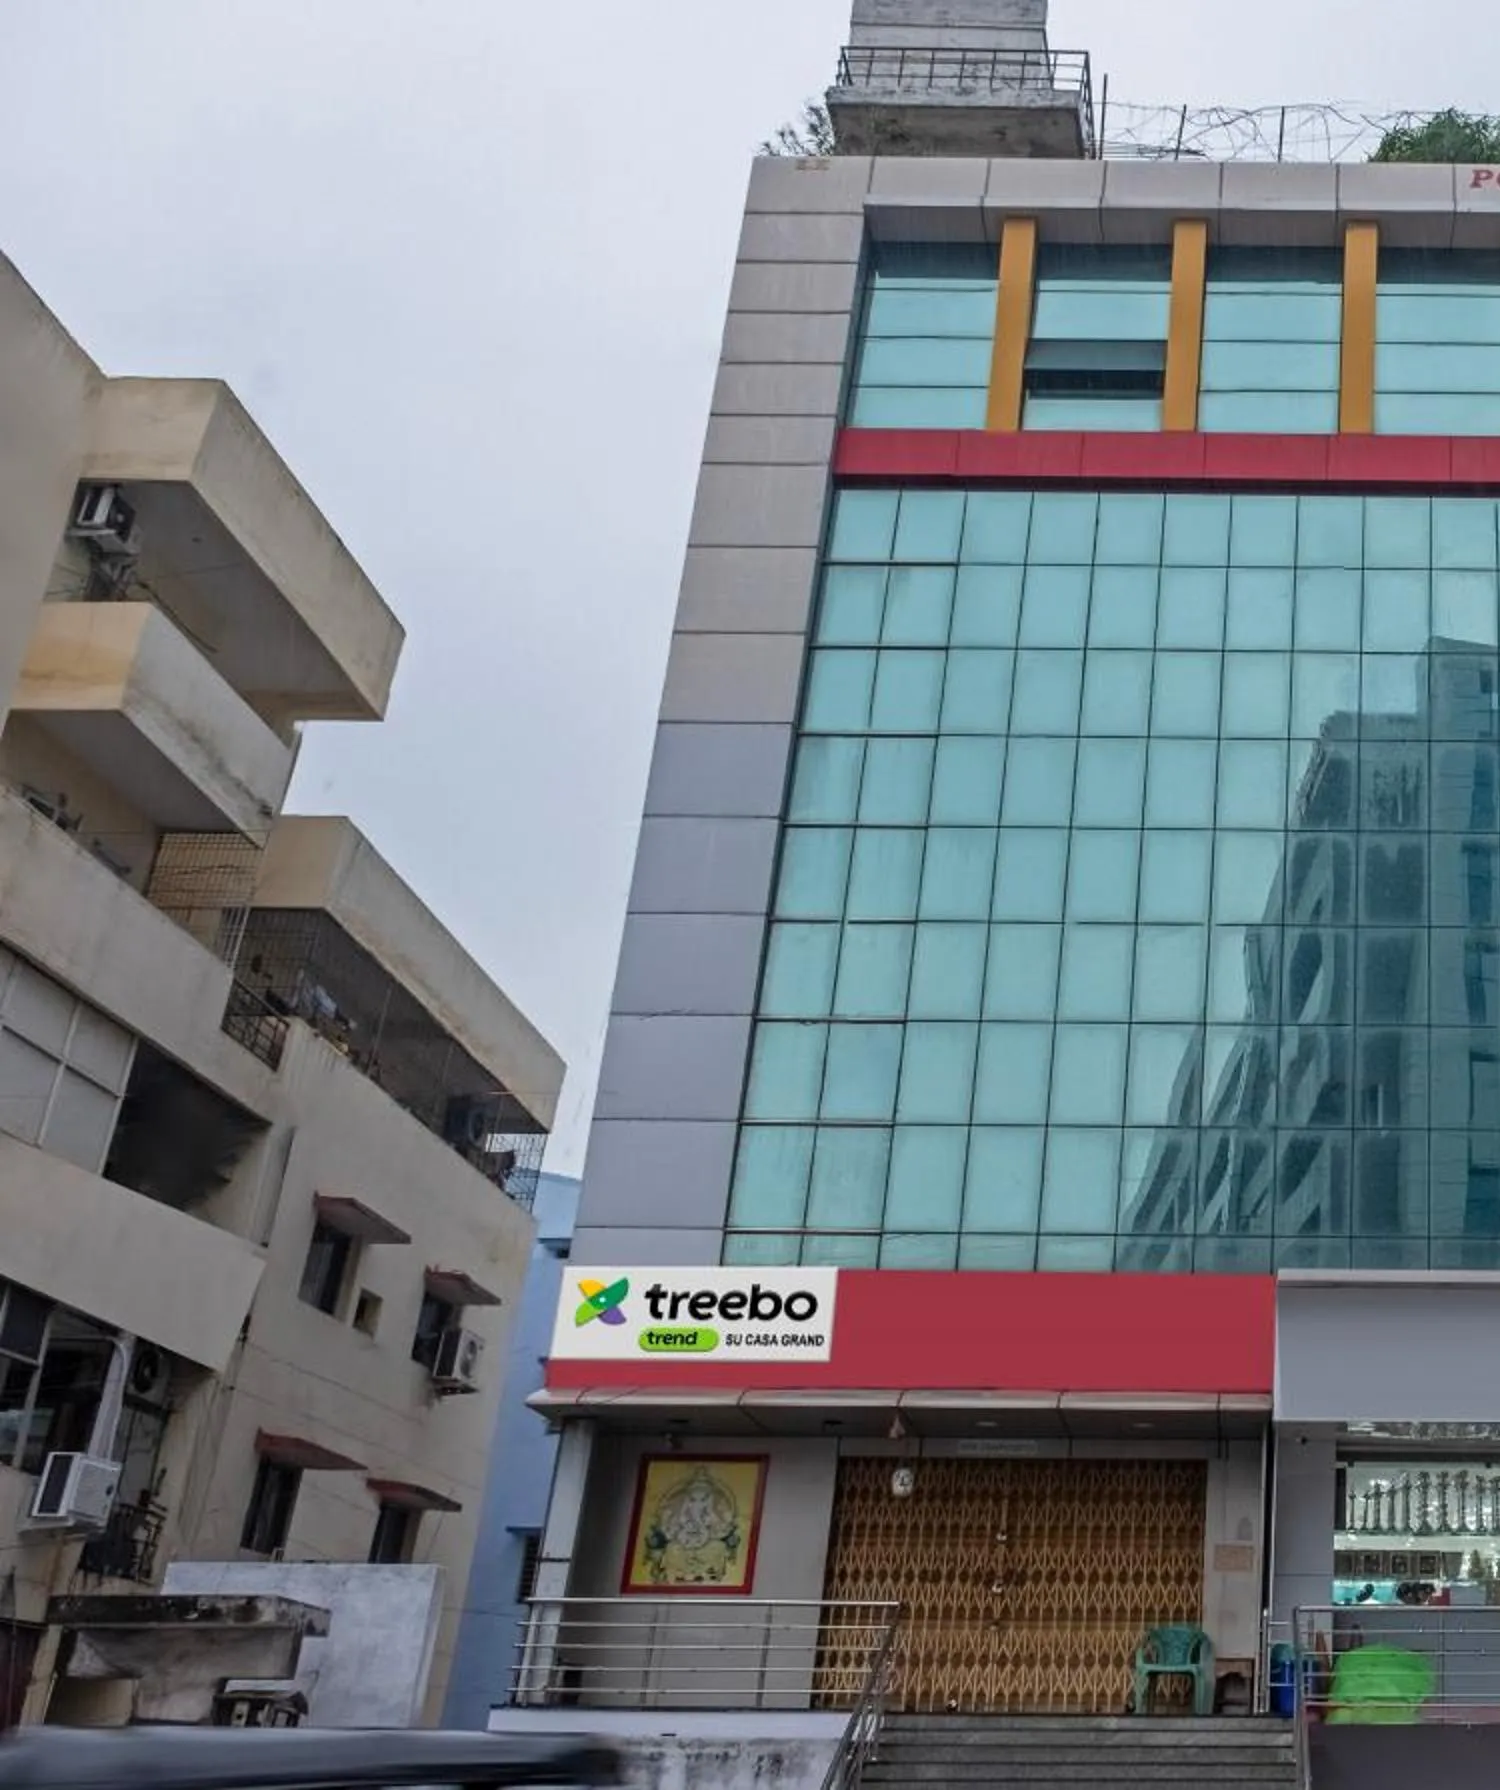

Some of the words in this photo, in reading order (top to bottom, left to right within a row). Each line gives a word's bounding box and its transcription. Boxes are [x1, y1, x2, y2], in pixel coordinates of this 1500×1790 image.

[645, 1284, 818, 1321] treebo
[646, 1331, 698, 1345] trend
[725, 1334, 742, 1346] SU
[745, 1334, 778, 1346] CASA
[781, 1334, 825, 1347] GRAND
